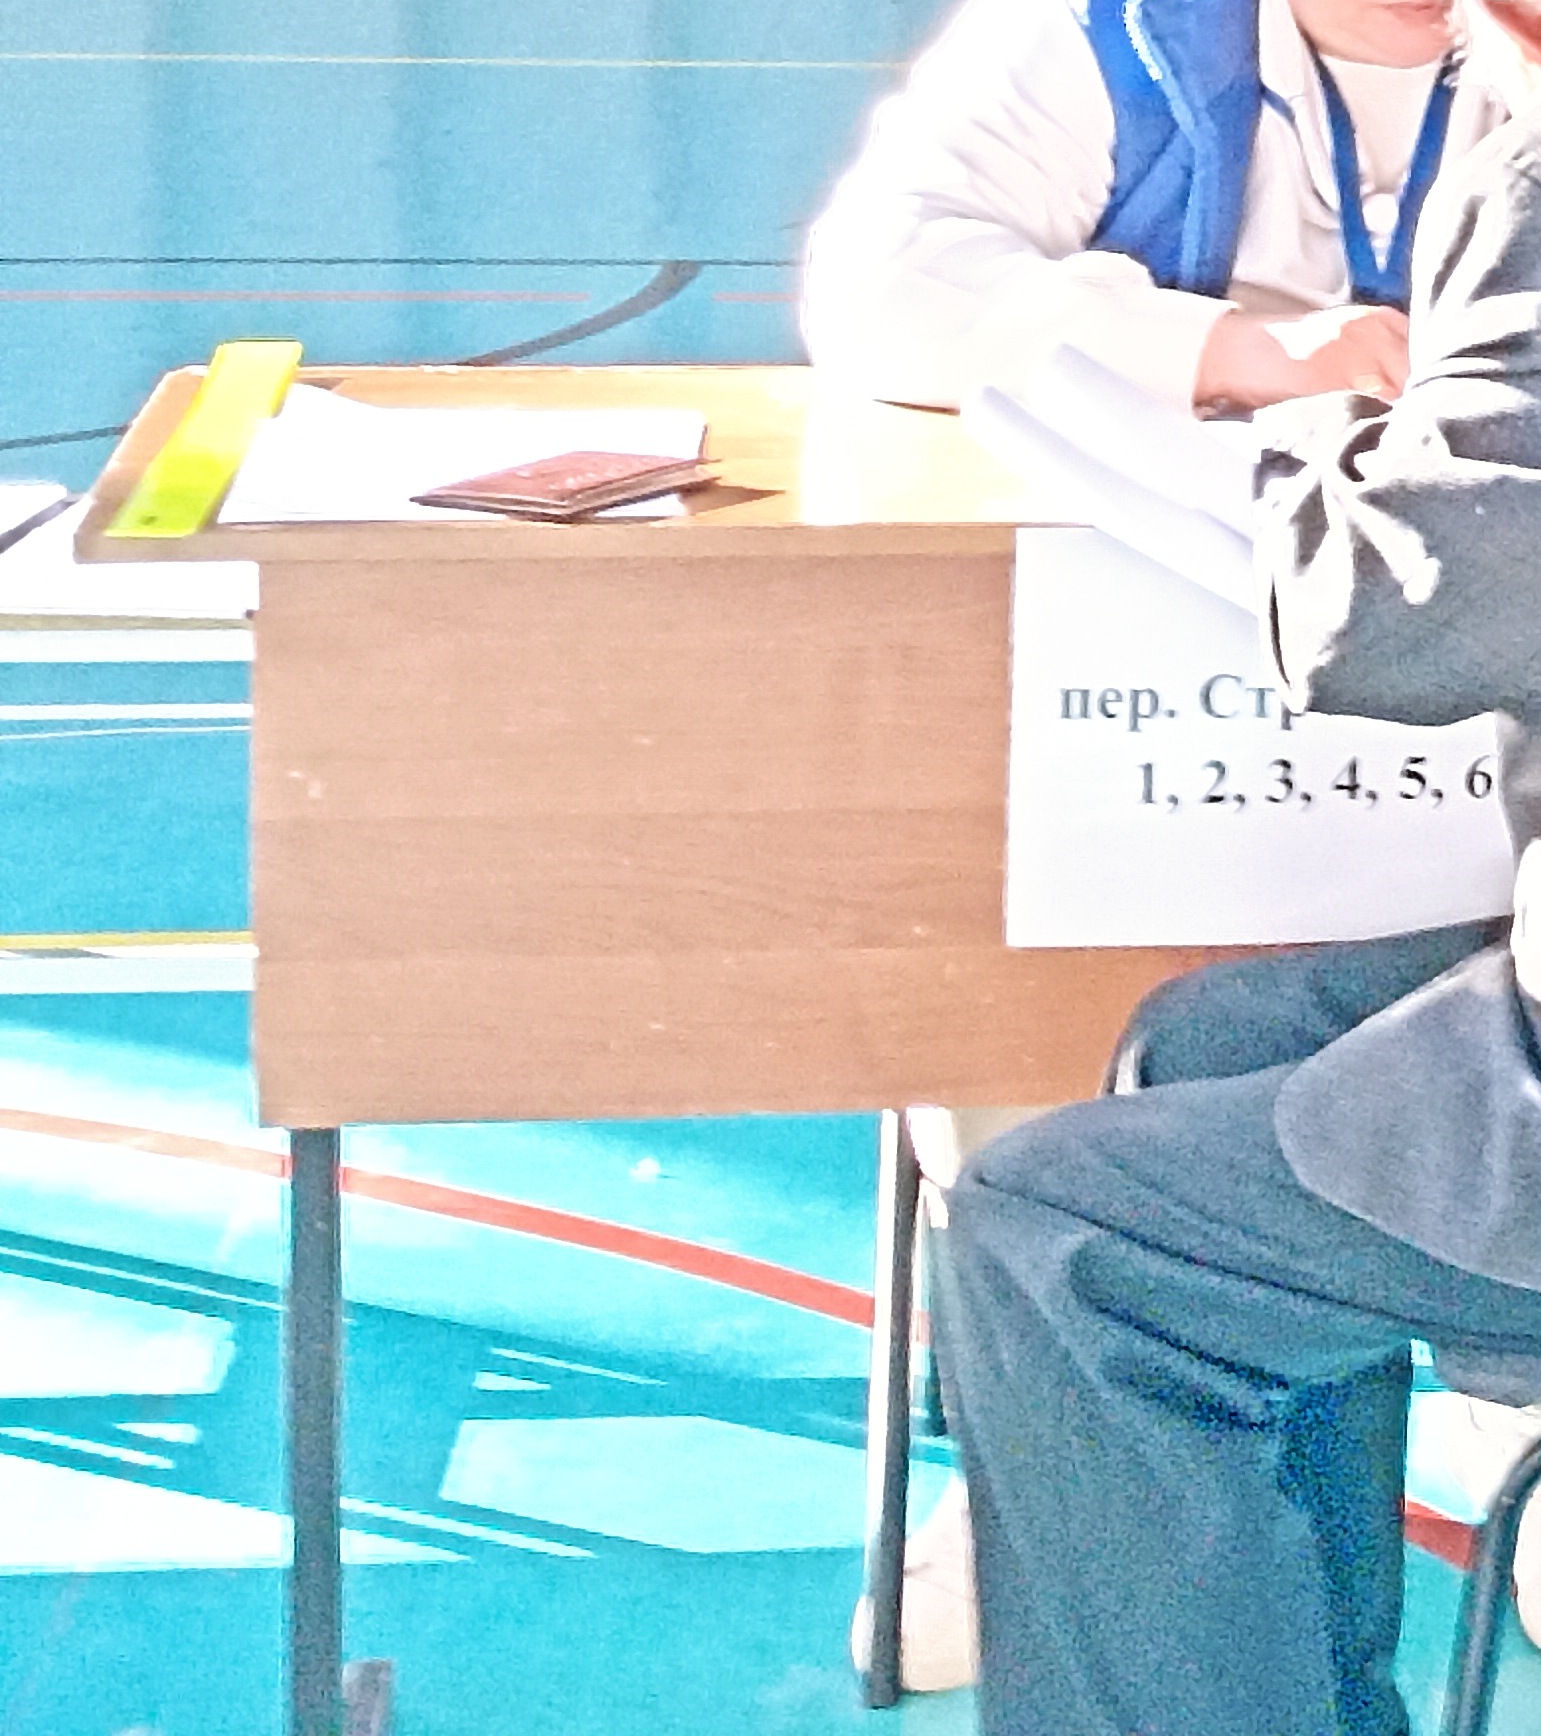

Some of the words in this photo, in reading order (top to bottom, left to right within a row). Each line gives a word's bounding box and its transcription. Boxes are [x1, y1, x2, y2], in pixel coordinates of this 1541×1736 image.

[1059, 686, 1177, 733] пер.
[1137, 761, 1179, 810] 1,
[1200, 759, 1247, 811] 2,
[1263, 758, 1313, 810] 3,
[1330, 756, 1380, 808] 4,
[1397, 755, 1445, 809] 5,
